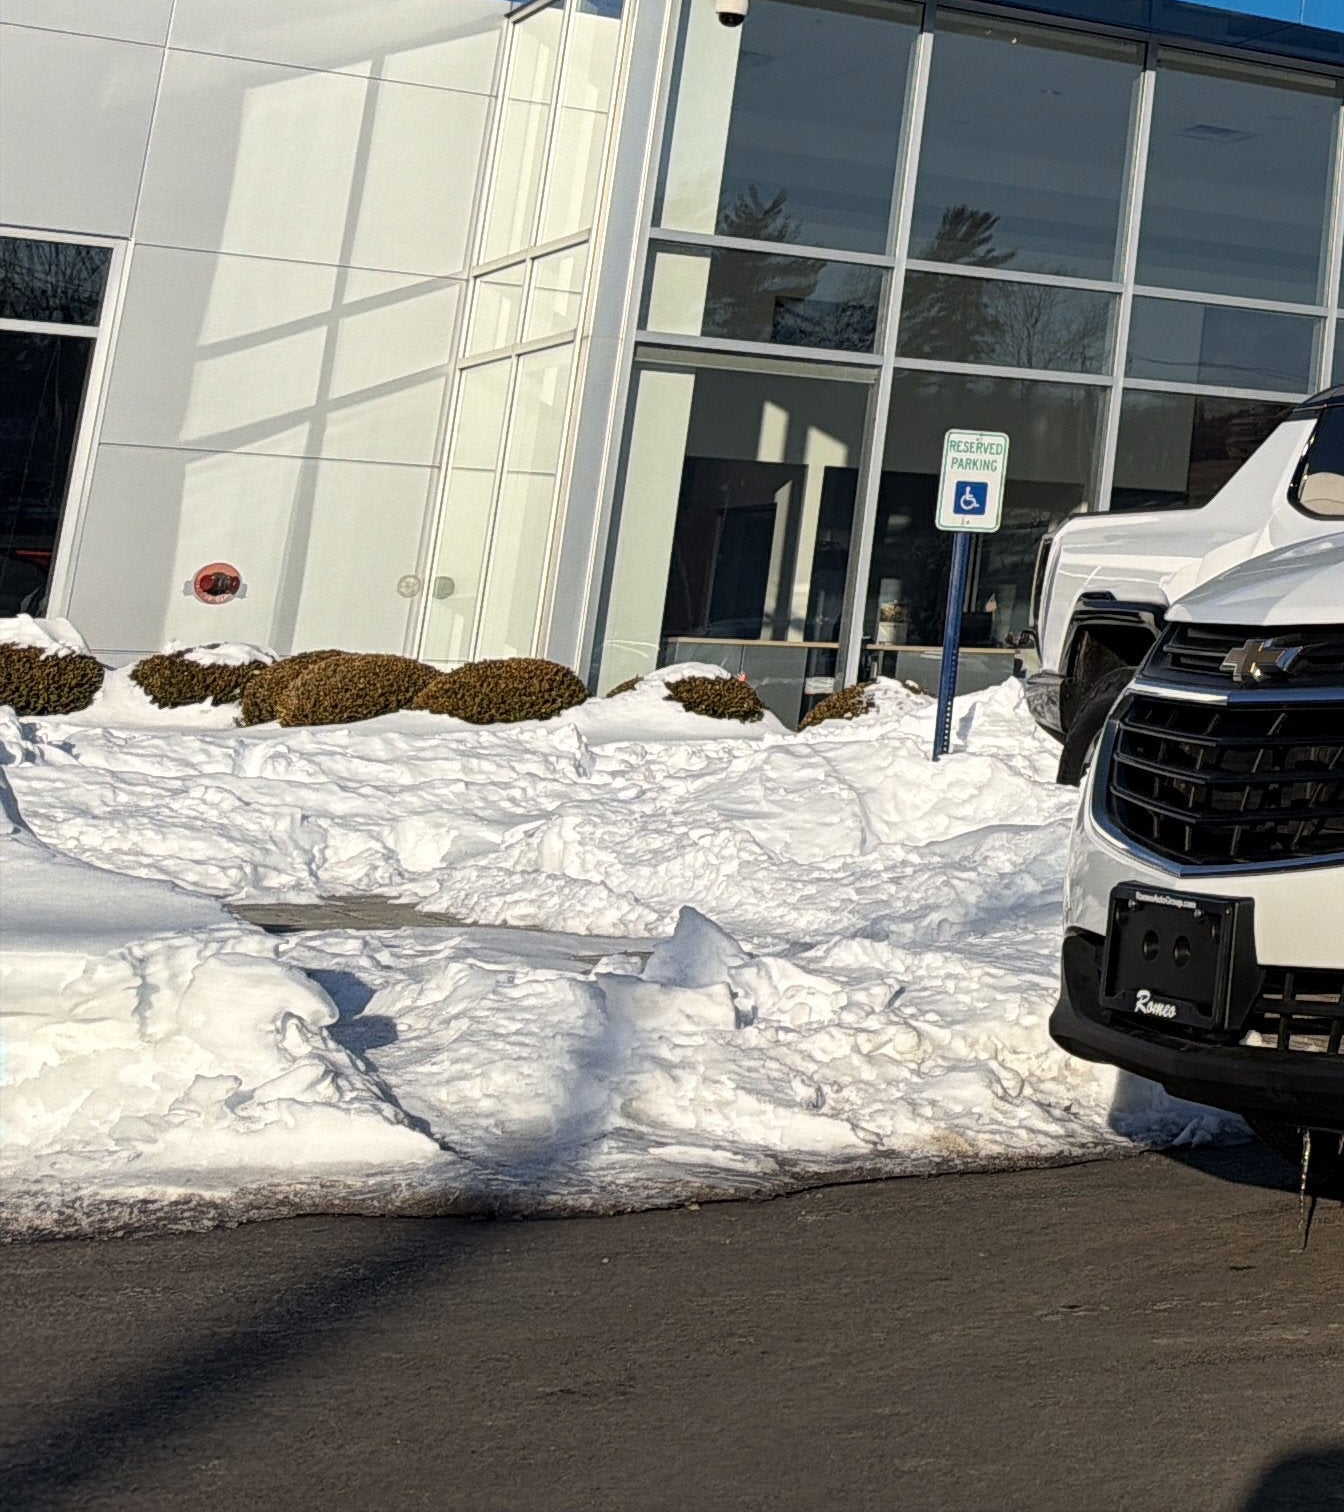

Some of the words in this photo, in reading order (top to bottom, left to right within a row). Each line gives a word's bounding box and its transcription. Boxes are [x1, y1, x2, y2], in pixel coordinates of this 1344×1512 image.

[950, 439, 1003, 456] RESERVED
[951, 456, 998, 472] PARKING
[1134, 989, 1177, 1019] Romeo
